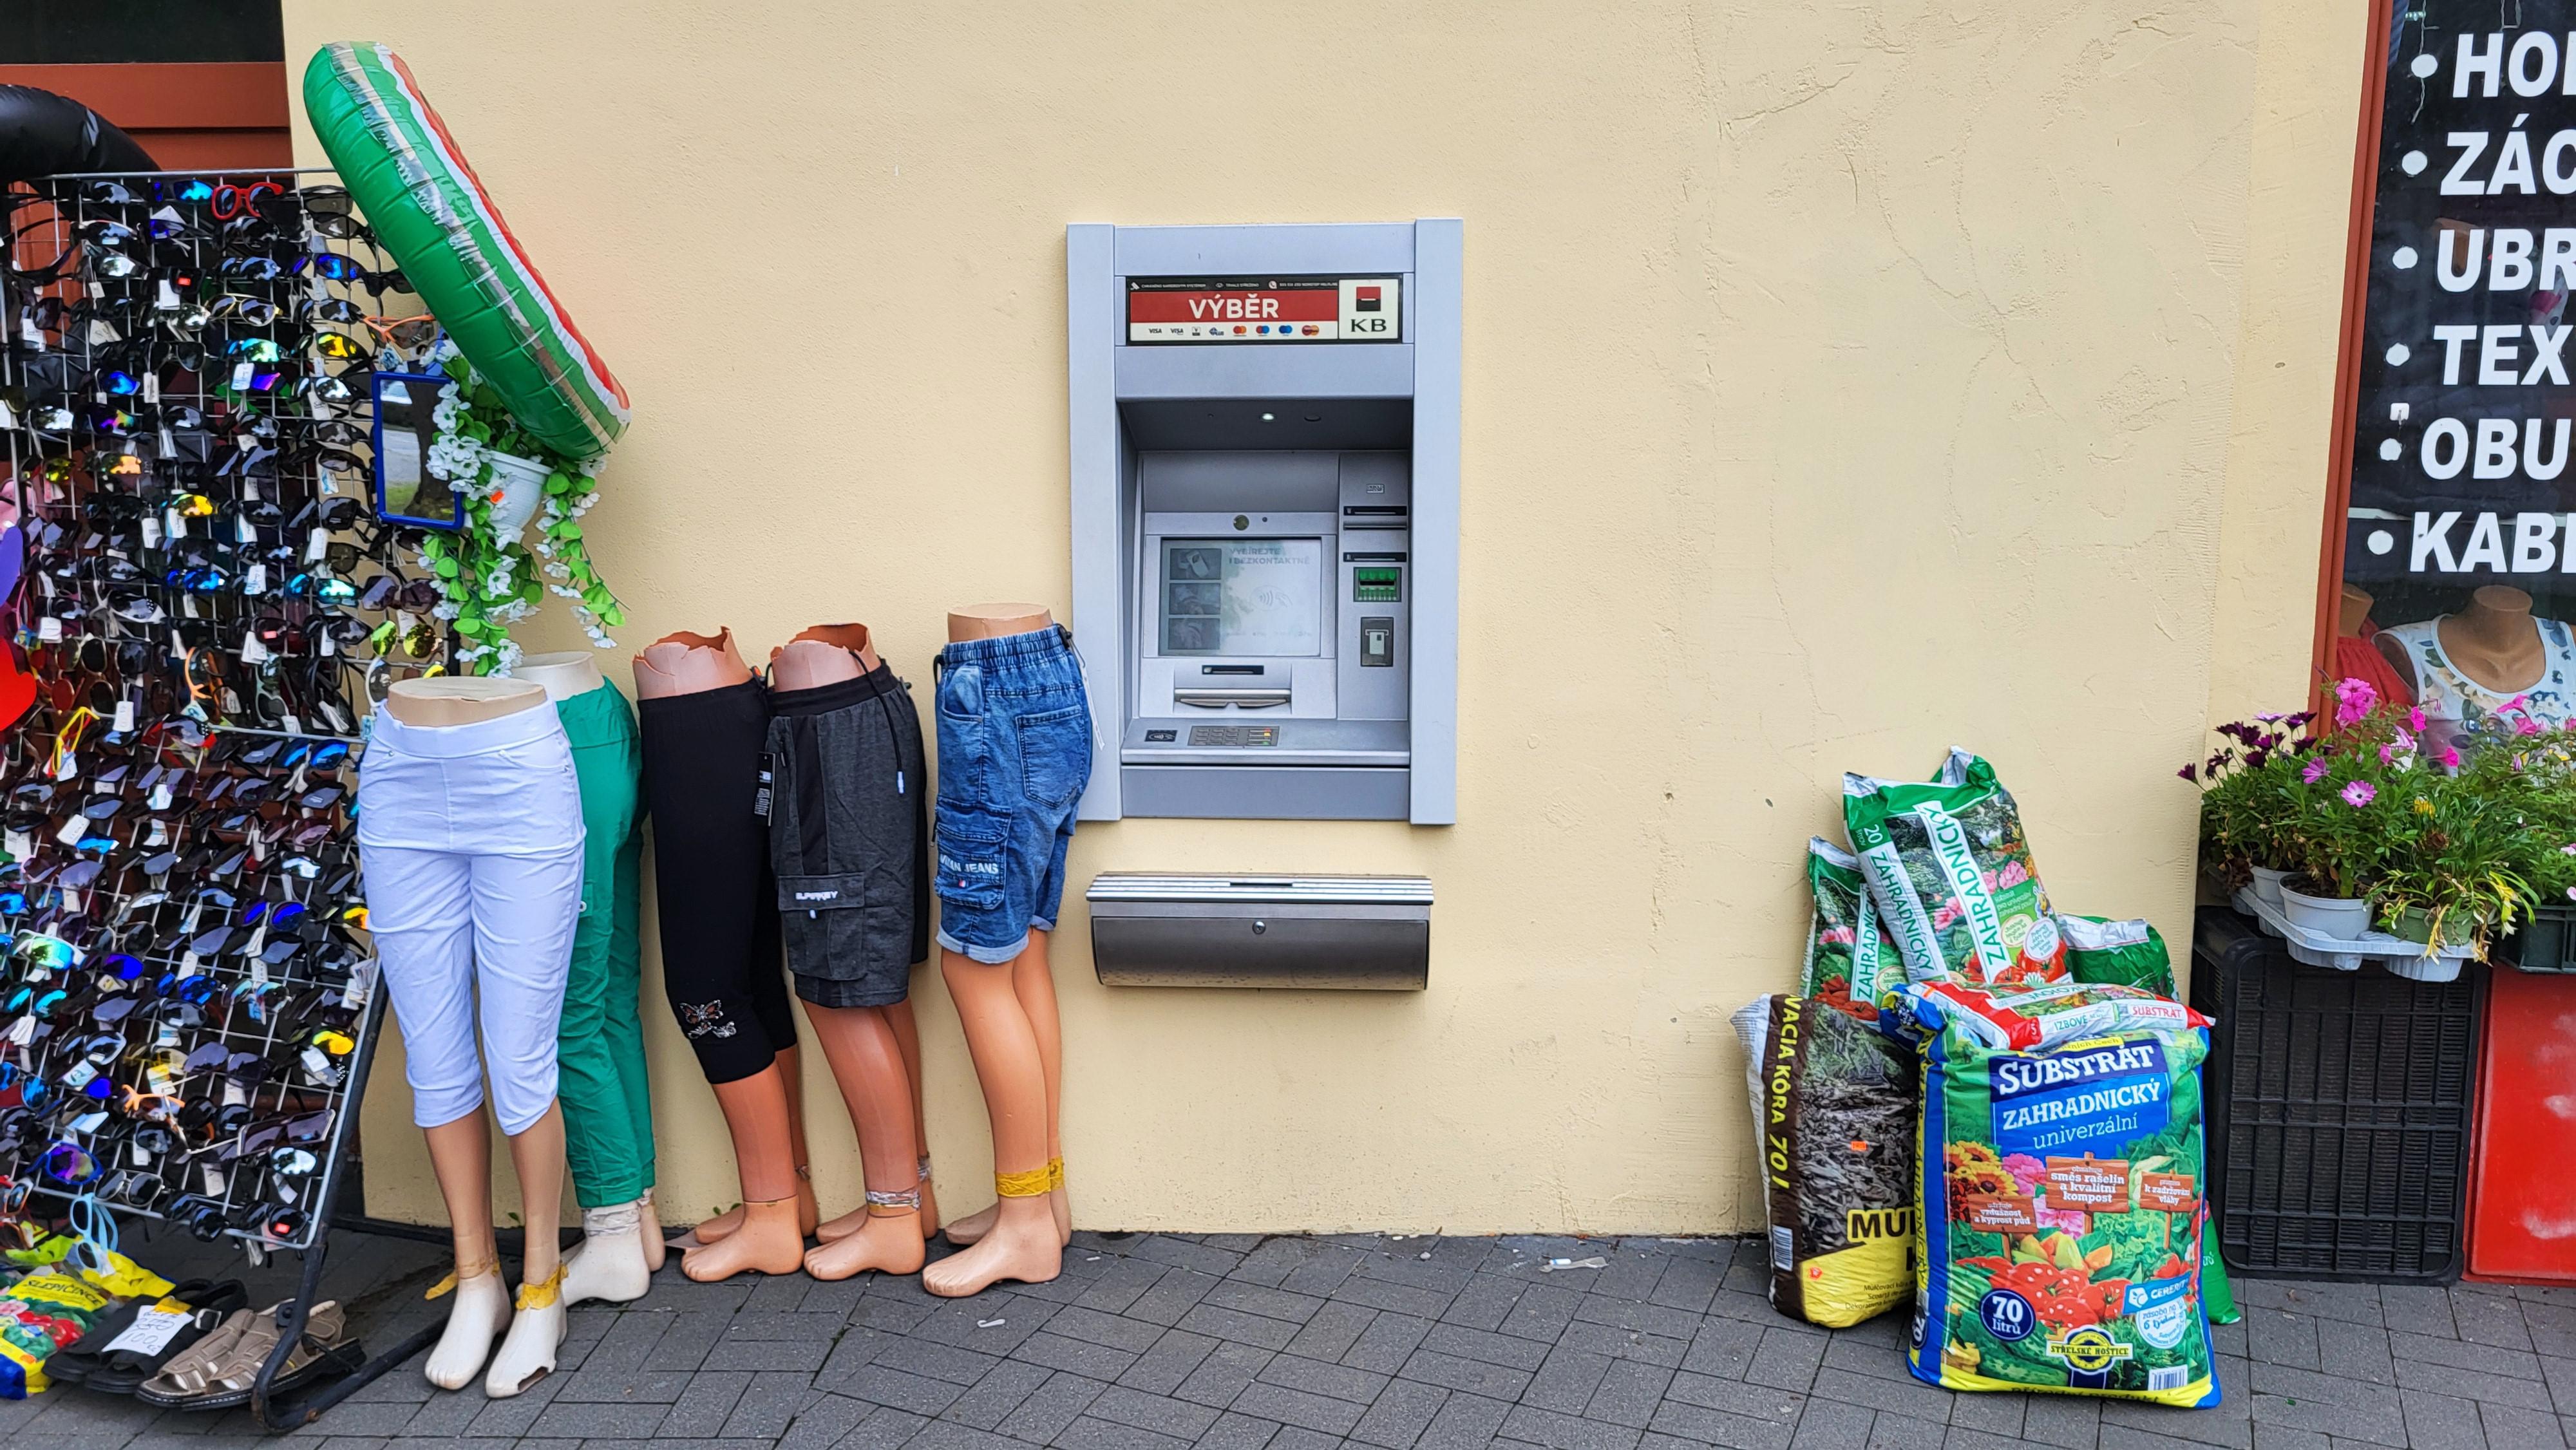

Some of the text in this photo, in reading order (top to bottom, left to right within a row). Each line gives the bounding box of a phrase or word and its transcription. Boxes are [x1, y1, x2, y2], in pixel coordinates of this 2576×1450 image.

[2434, 227, 2576, 292] UBR
[1189, 293, 1279, 319] VÝBĚR
[1350, 319, 1387, 332] KB
[2433, 325, 2571, 386] TEX
[2421, 417, 2571, 480] OBU
[1863, 824, 1883, 843] 20
[965, 862, 999, 874] JEANS
[1857, 889, 1878, 999] ZAHRADNIC
[2132, 1005, 2182, 1019] SUBSTRÁT
[1777, 995, 1803, 1059] VACIA
[1998, 1044, 2154, 1095] SUBSTRÁT
[1771, 1064, 1791, 1124] KÔRA
[2003, 1078, 2161, 1130] ZAHRADNICKÝ
[2033, 1113, 2138, 1149] univerzální
[1769, 1133, 1788, 1171] 70
[2050, 1172, 2125, 1184] směs rašelin
[2070, 1182, 2116, 1193] kvalitní
[2063, 1191, 2112, 1204] kompost
[1993, 1296, 2023, 1323] 70
[1912, 1316, 1926, 1342] 70
[1993, 1318, 2022, 1335] litrů
[2143, 1321, 2150, 1330] 6
[2096, 1347, 2129, 1355] HOŠTICE
